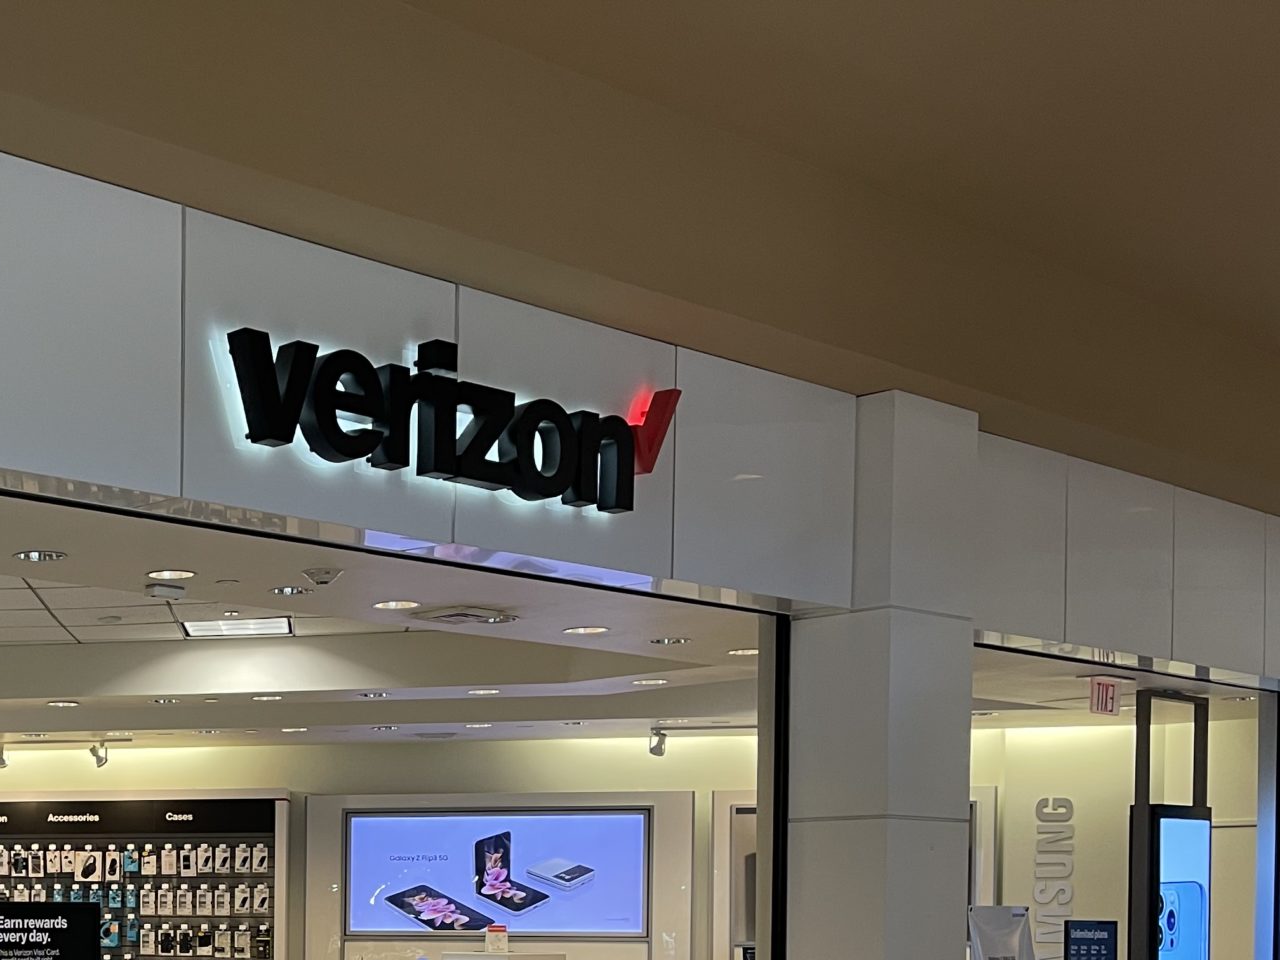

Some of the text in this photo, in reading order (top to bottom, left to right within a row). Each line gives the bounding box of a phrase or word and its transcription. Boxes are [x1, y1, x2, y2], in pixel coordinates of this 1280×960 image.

[226, 327, 635, 514] verizon
[47, 812, 100, 822] Accessories
[165, 812, 193, 821] Cases
[23, 915, 68, 929] rewards
[28, 929, 51, 945] day.
